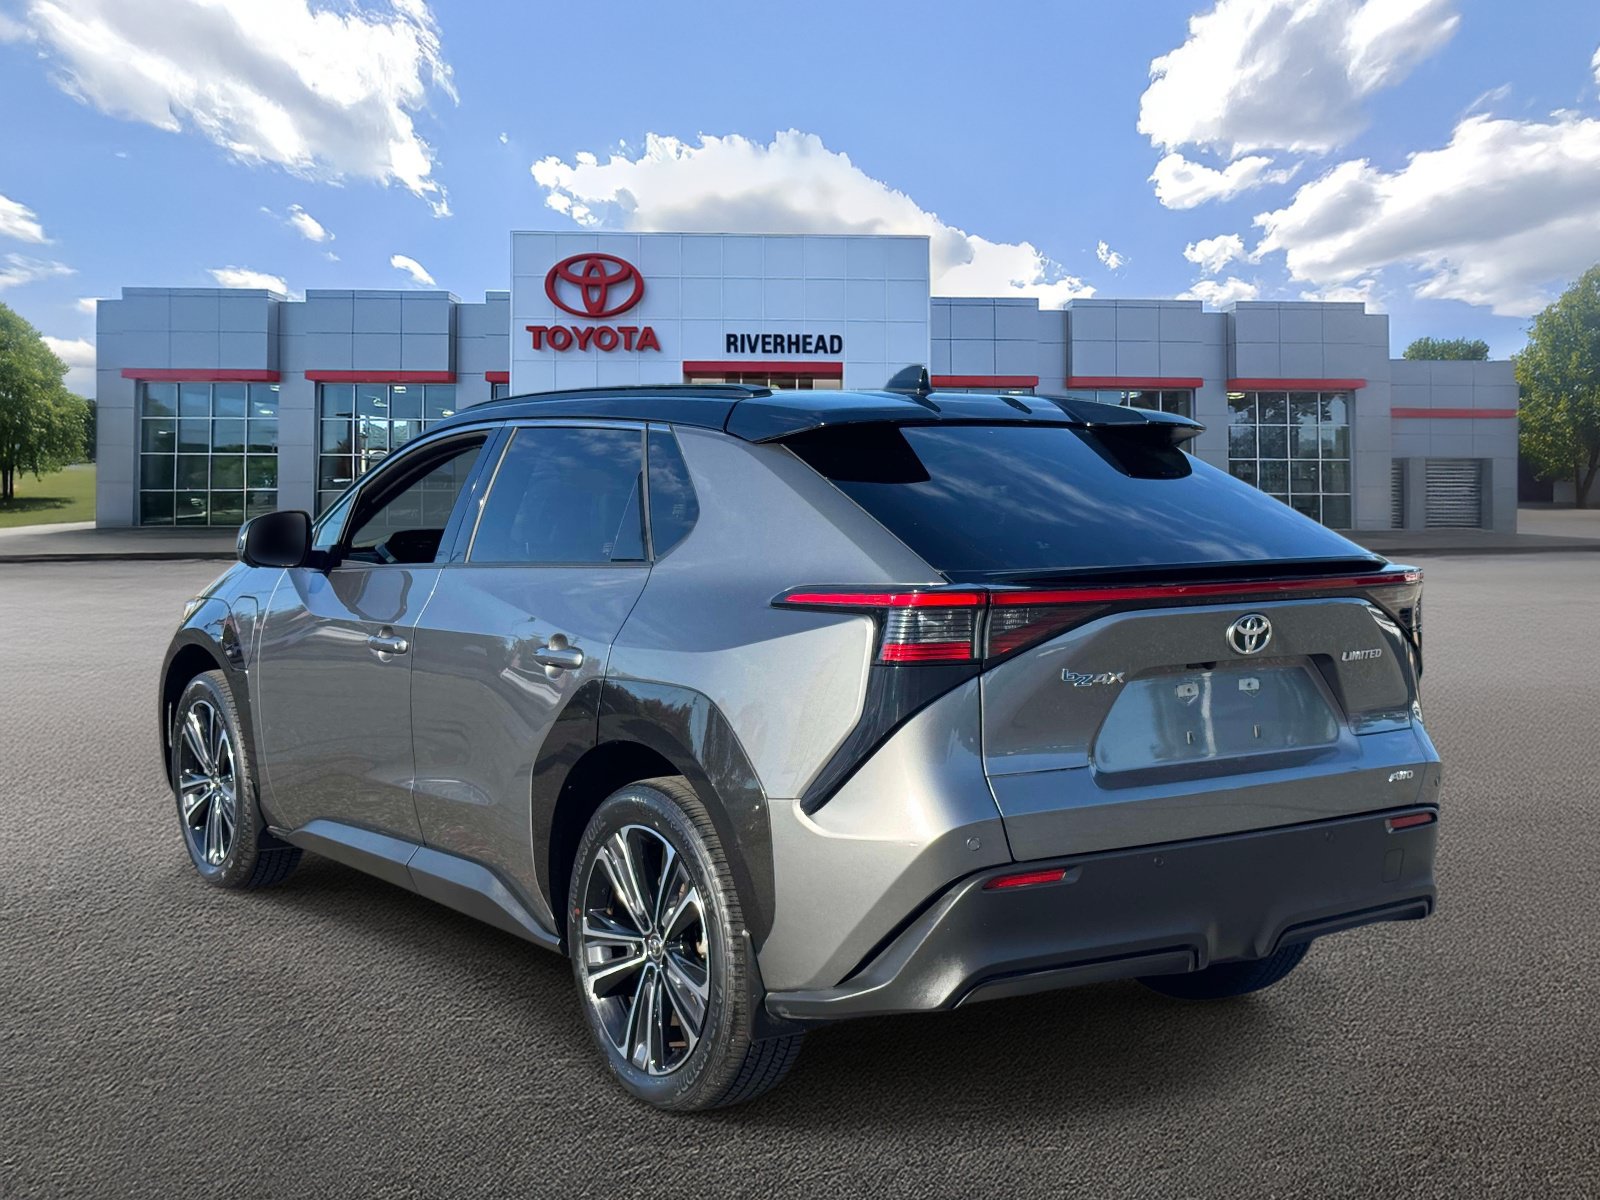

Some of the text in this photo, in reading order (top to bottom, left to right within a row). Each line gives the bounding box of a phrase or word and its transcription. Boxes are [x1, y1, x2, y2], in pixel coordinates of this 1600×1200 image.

[525, 325, 661, 352] TOYOTA
[726, 333, 843, 354] RIVERHEAD
[1341, 648, 1382, 661] LIMITED
